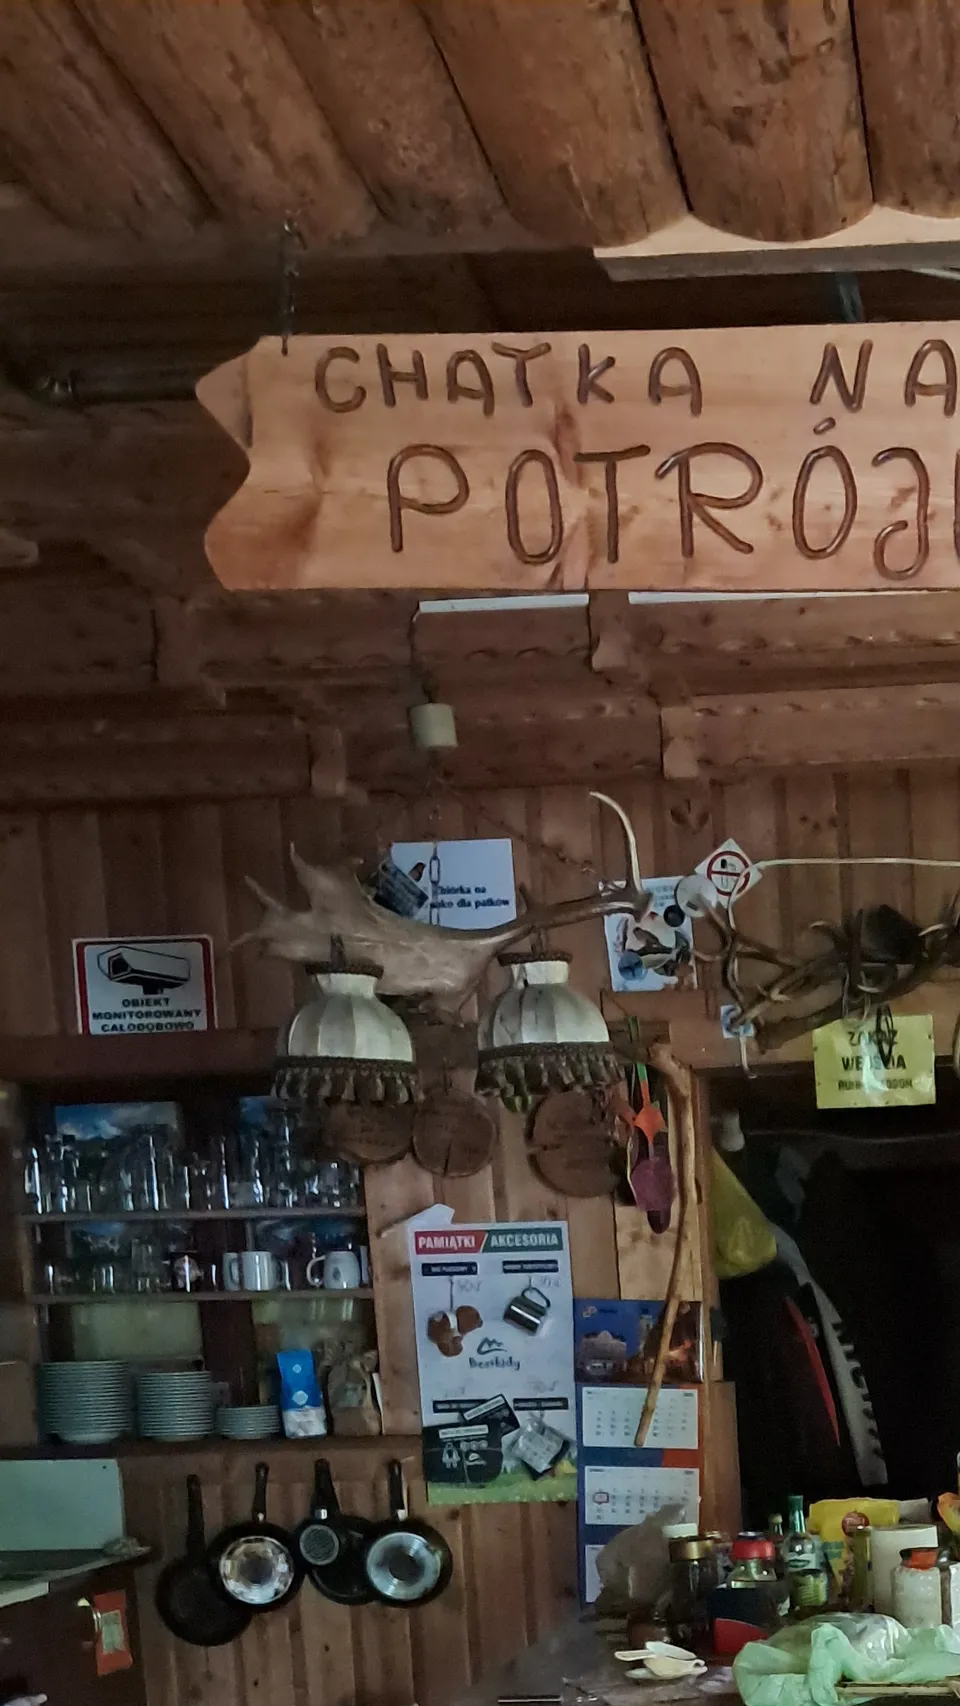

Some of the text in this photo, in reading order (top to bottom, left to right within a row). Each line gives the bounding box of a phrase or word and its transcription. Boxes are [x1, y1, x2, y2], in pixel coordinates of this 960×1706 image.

[315, 339, 958, 417] CHATKA NA
[121, 997, 171, 1008] OBIEKT
[92, 1009, 202, 1021] MONITOROWANY
[418, 1233, 559, 1250] PAMIĄTKI AKCESORIA
